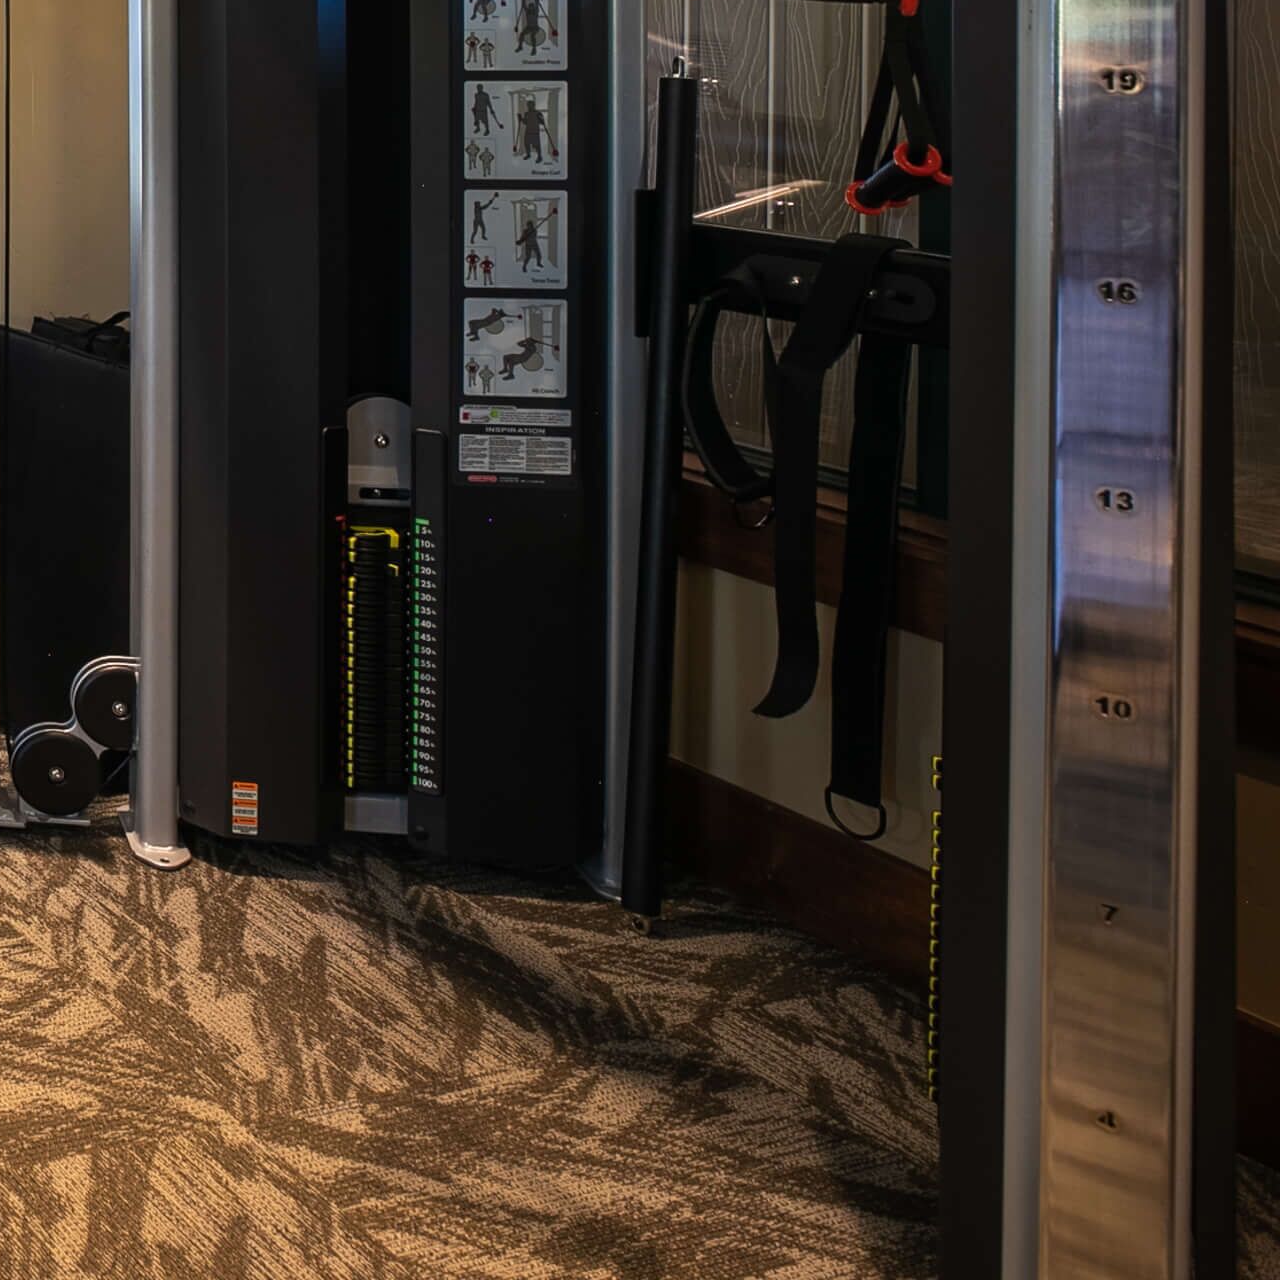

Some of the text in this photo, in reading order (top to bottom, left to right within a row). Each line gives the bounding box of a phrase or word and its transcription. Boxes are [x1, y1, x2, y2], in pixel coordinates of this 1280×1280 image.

[1099, 68, 1138, 91] 19
[1099, 281, 1137, 303] 16
[485, 426, 546, 434] INSPIRATION
[1098, 489, 1135, 511] 13
[421, 525, 428, 534] 5
[421, 539, 431, 548] 10
[421, 552, 431, 561] 15
[421, 566, 431, 575] 20
[420, 579, 431, 588] 25
[420, 593, 431, 602] 30
[420, 606, 431, 615] 35
[420, 619, 431, 628] 40
[420, 632, 430, 641] 45
[420, 646, 430, 655] 50
[420, 659, 430, 668] 55
[420, 673, 430, 682] 60
[419, 685, 430, 694] 65
[419, 699, 430, 708] 70
[1096, 696, 1131, 720] 10
[419, 712, 430, 721] 75
[419, 725, 430, 734] 80
[419, 738, 429, 747] 85
[419, 752, 429, 760] 90
[419, 765, 429, 774] 95
[418, 779, 433, 788] 100
[1102, 904, 1121, 924] 7
